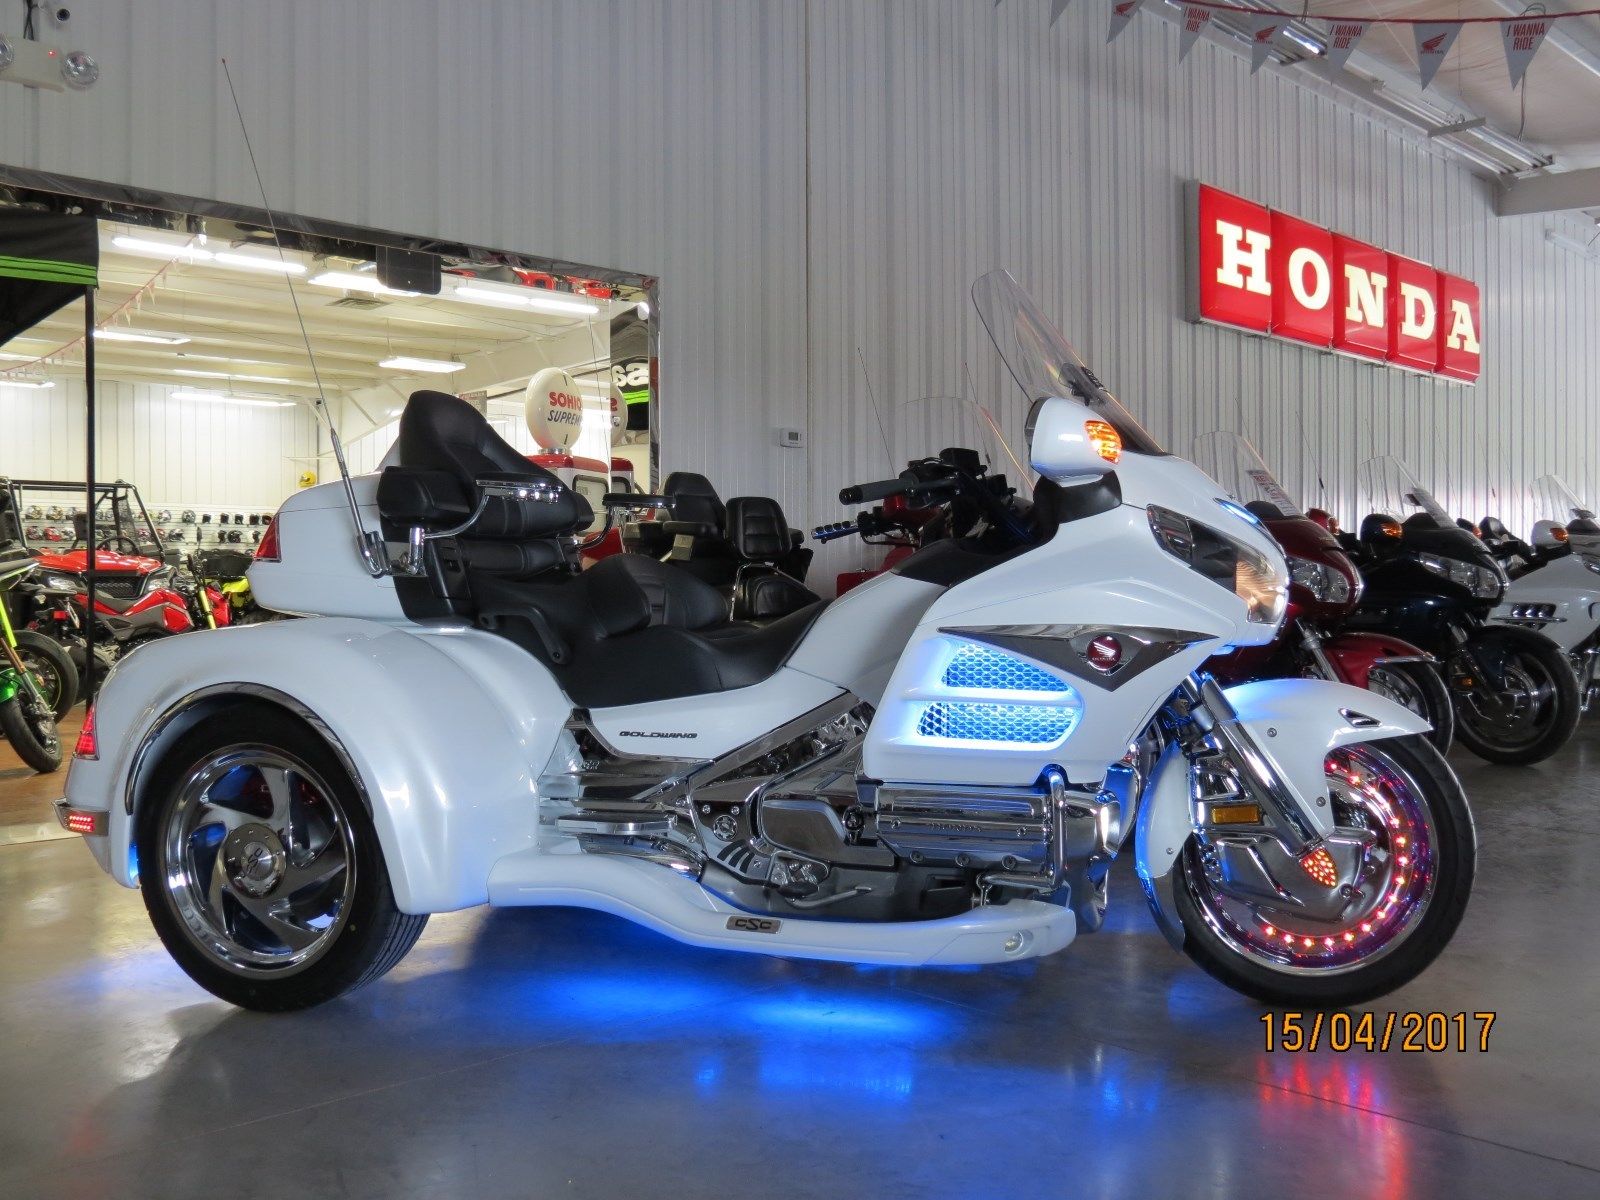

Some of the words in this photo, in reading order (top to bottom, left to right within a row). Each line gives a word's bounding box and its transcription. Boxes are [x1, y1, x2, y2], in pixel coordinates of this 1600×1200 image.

[1188, 8, 1210, 22] WANNA
[1185, 20, 1201, 32] RIDE
[1335, 25, 1363, 37] WANNA
[1513, 22, 1545, 37] WANNA
[1333, 37, 1352, 49] RIDE
[1513, 36, 1535, 51] RIDE
[1216, 219, 1480, 355] HONDA
[547, 409, 583, 427] SUPREM
[619, 730, 698, 739] GOLDWING
[734, 917, 773, 931] CSC
